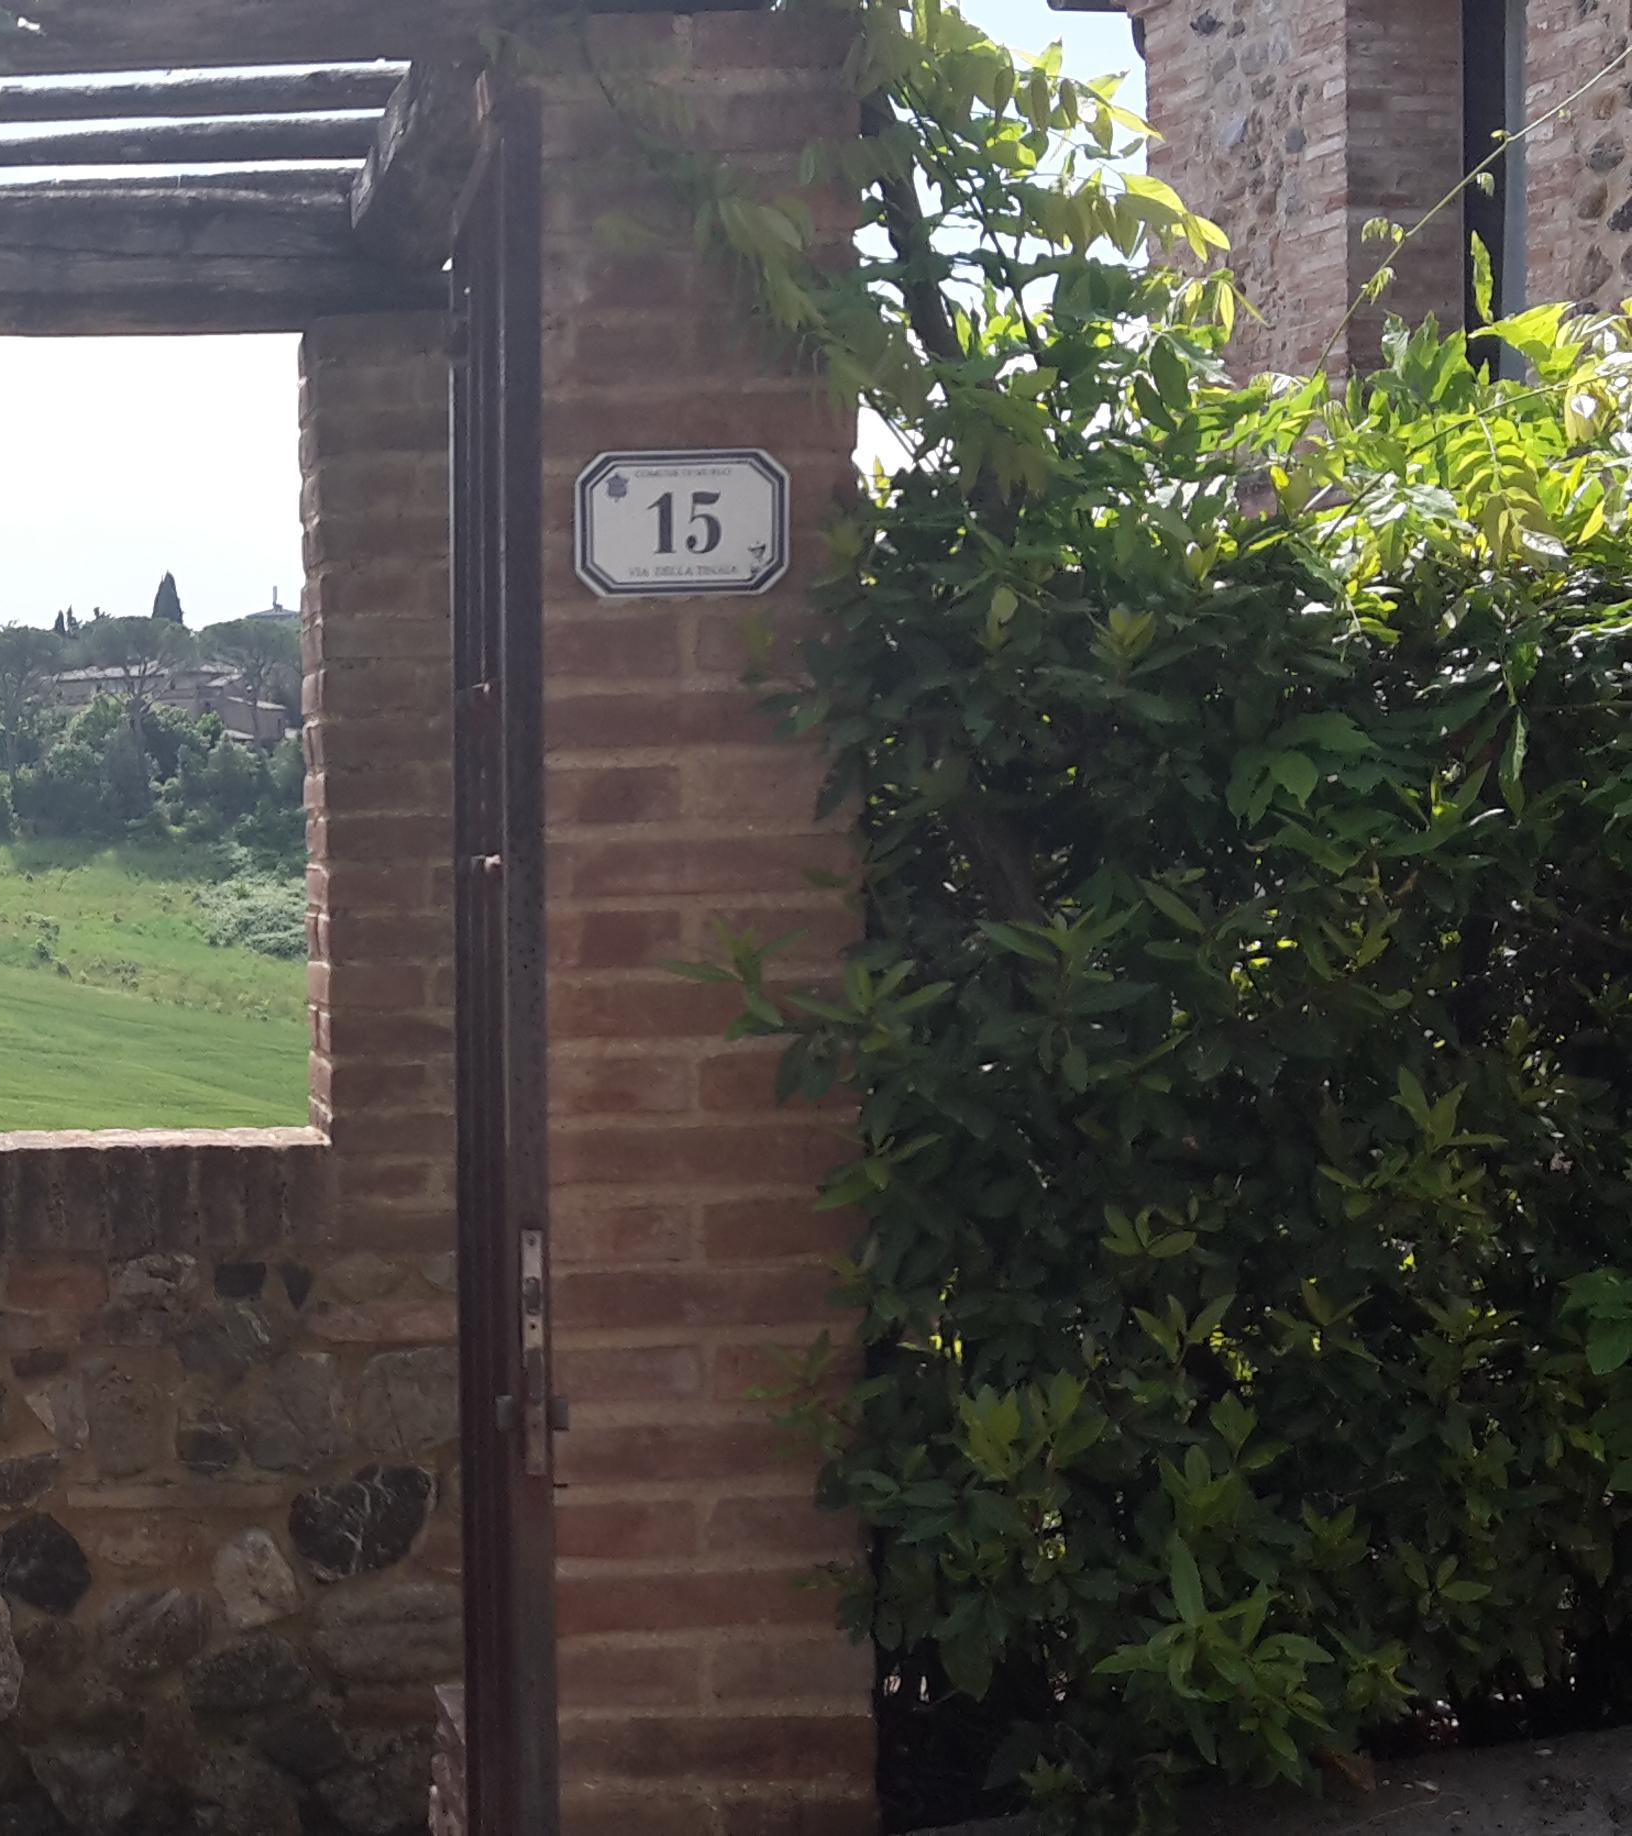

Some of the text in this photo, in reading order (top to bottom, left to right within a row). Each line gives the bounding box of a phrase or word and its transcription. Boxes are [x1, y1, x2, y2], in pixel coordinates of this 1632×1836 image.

[646, 491, 722, 555] 15
[628, 566, 650, 577] VIA
[653, 565, 694, 577] DELLA
